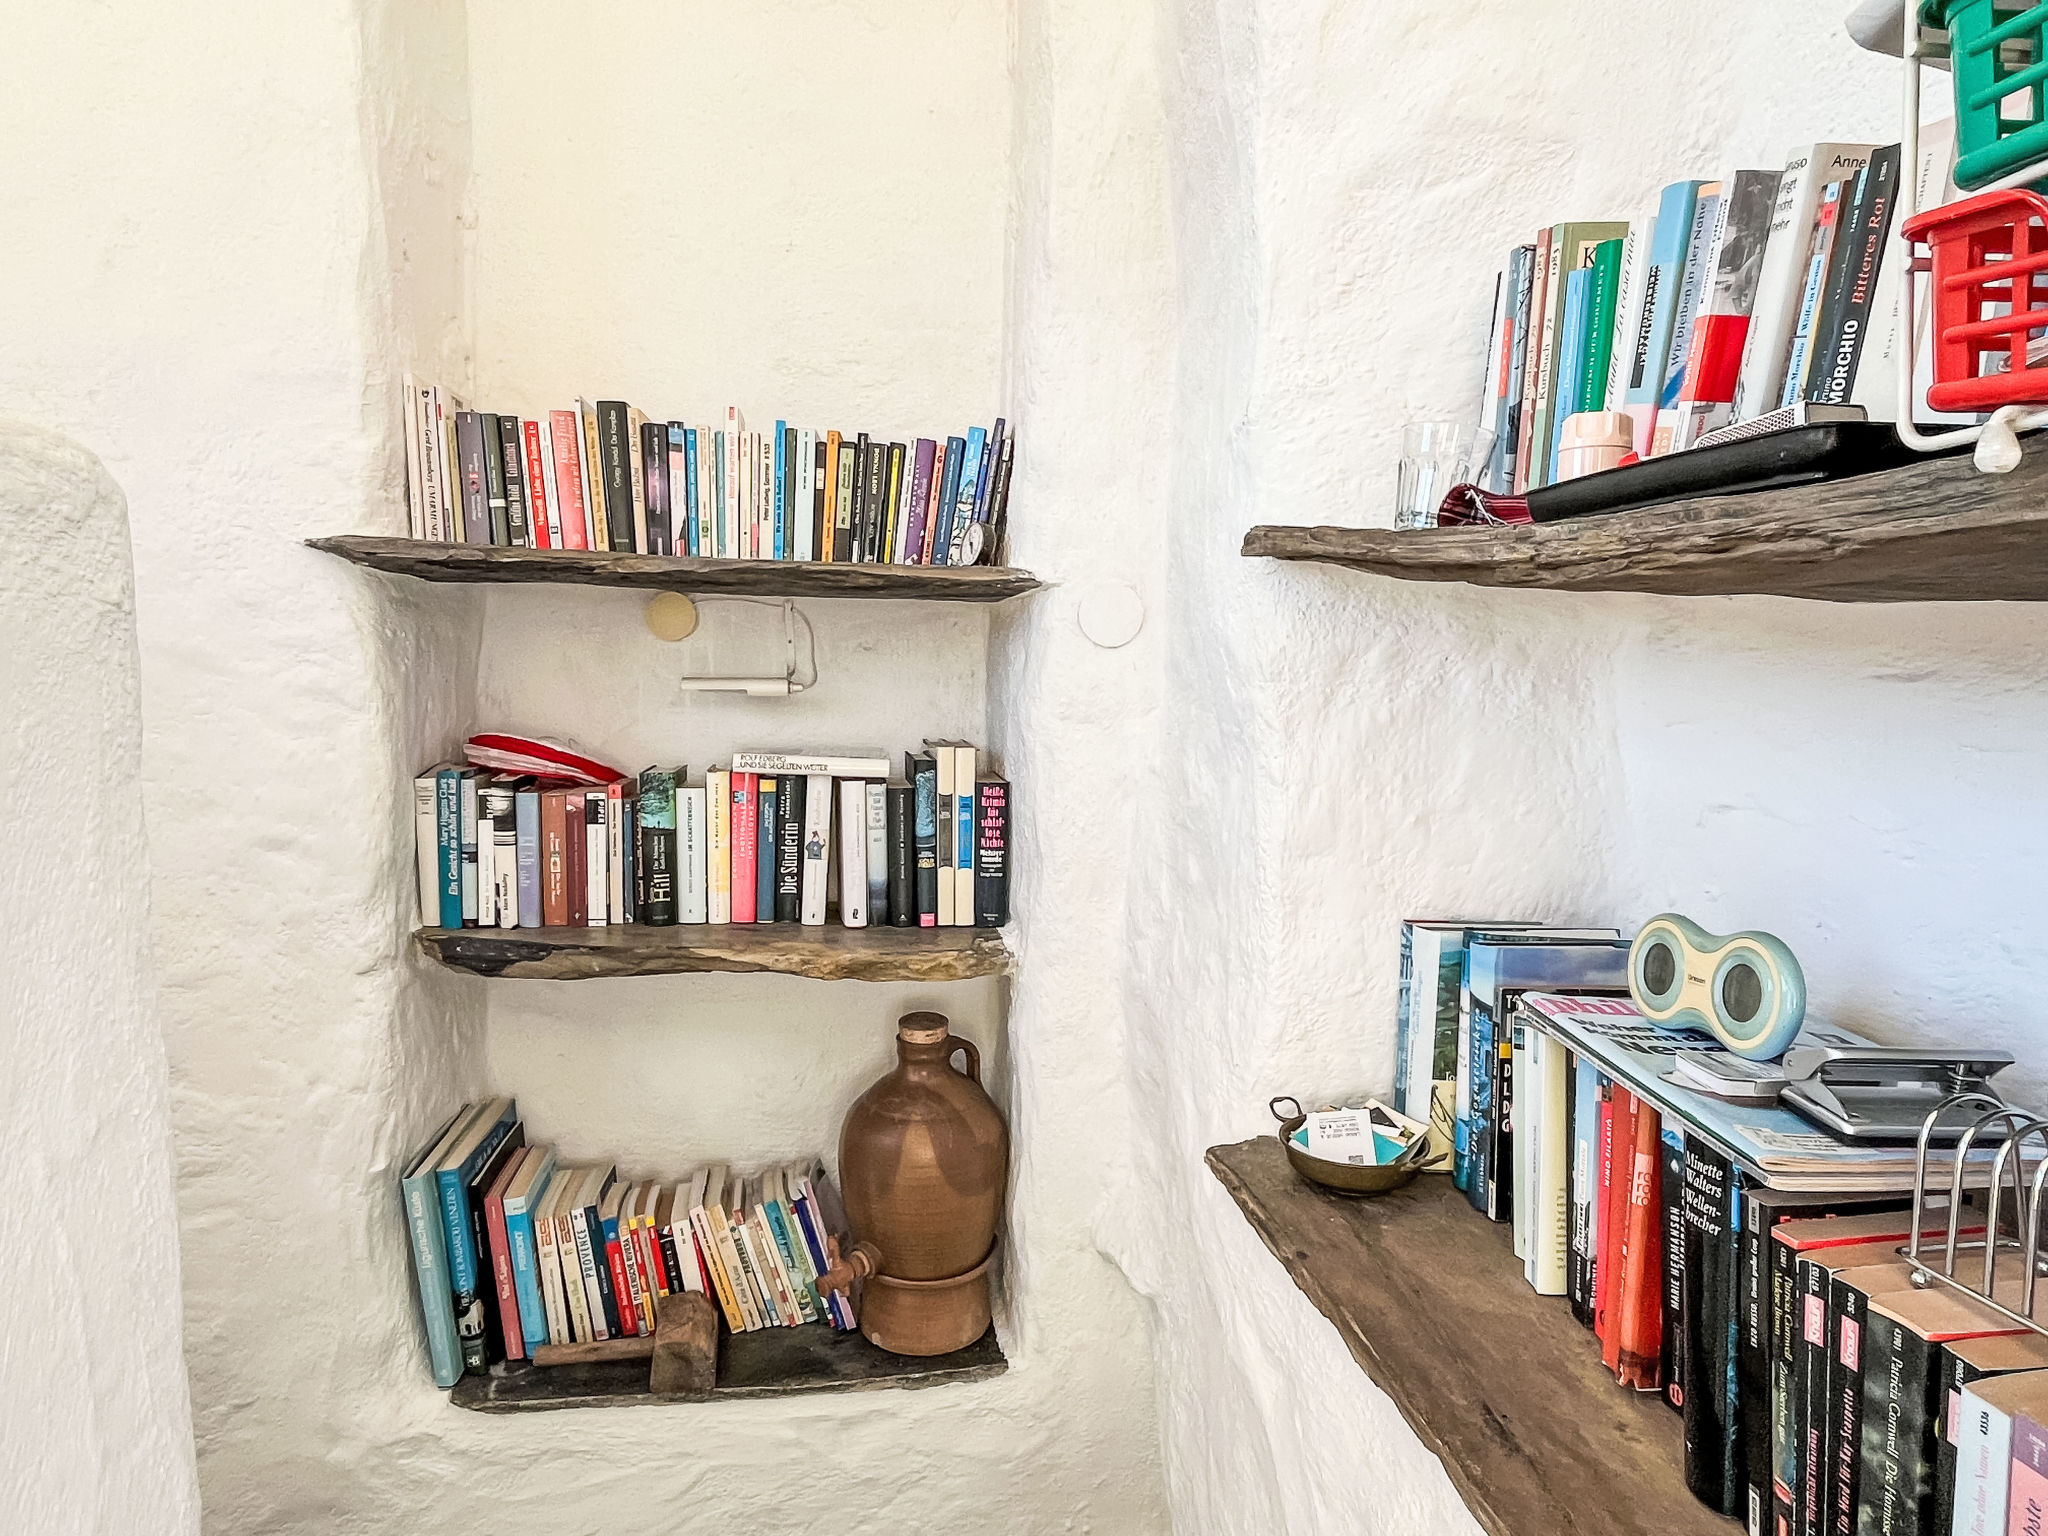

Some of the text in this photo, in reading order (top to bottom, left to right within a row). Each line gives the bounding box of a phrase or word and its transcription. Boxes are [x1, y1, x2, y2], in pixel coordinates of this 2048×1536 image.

[1831, 154, 1867, 169] Anne
[1670, 202, 1708, 367] Wir bleiben in der Nähe
[1829, 319, 1859, 405] MORCHIO
[1852, 233, 1878, 304] Bitteres
[1867, 196, 1886, 230] Rot
[1538, 344, 1552, 400] Kursbuch
[1550, 248, 1561, 276] 1983
[1787, 382, 1799, 406] runo
[870, 447, 880, 495] DONNA LEON
[740, 754, 787, 763] ROLF EDBERG
[779, 822, 799, 895] Die Sünderin
[448, 881, 458, 896] Ein
[652, 873, 671, 904] Hill
[1603, 1160, 1612, 1188] NINO
[1685, 1150, 1724, 1181] Minette
[1685, 1167, 1723, 1199] Walters
[1685, 1187, 1721, 1218] Wellen-
[1685, 1204, 1722, 1237] brecher
[576, 1228, 596, 1279] PROVENCE
[1669, 1206, 1681, 1279] HERMANSON
[1669, 1281, 1680, 1311] MARIE
[1809, 1266, 1821, 1292] 67103
[1781, 1275, 1794, 1362] Patricia Cornwell
[1888, 1356, 1904, 1400] Patricia
[1840, 1386, 1855, 1438] Scarpetta
[1885, 1402, 1902, 1459] Cornwell
[1884, 1460, 1898, 1483] Die
[1881, 1486, 1898, 1536] Hornisse
[2021, 1497, 2042, 1536] bste
